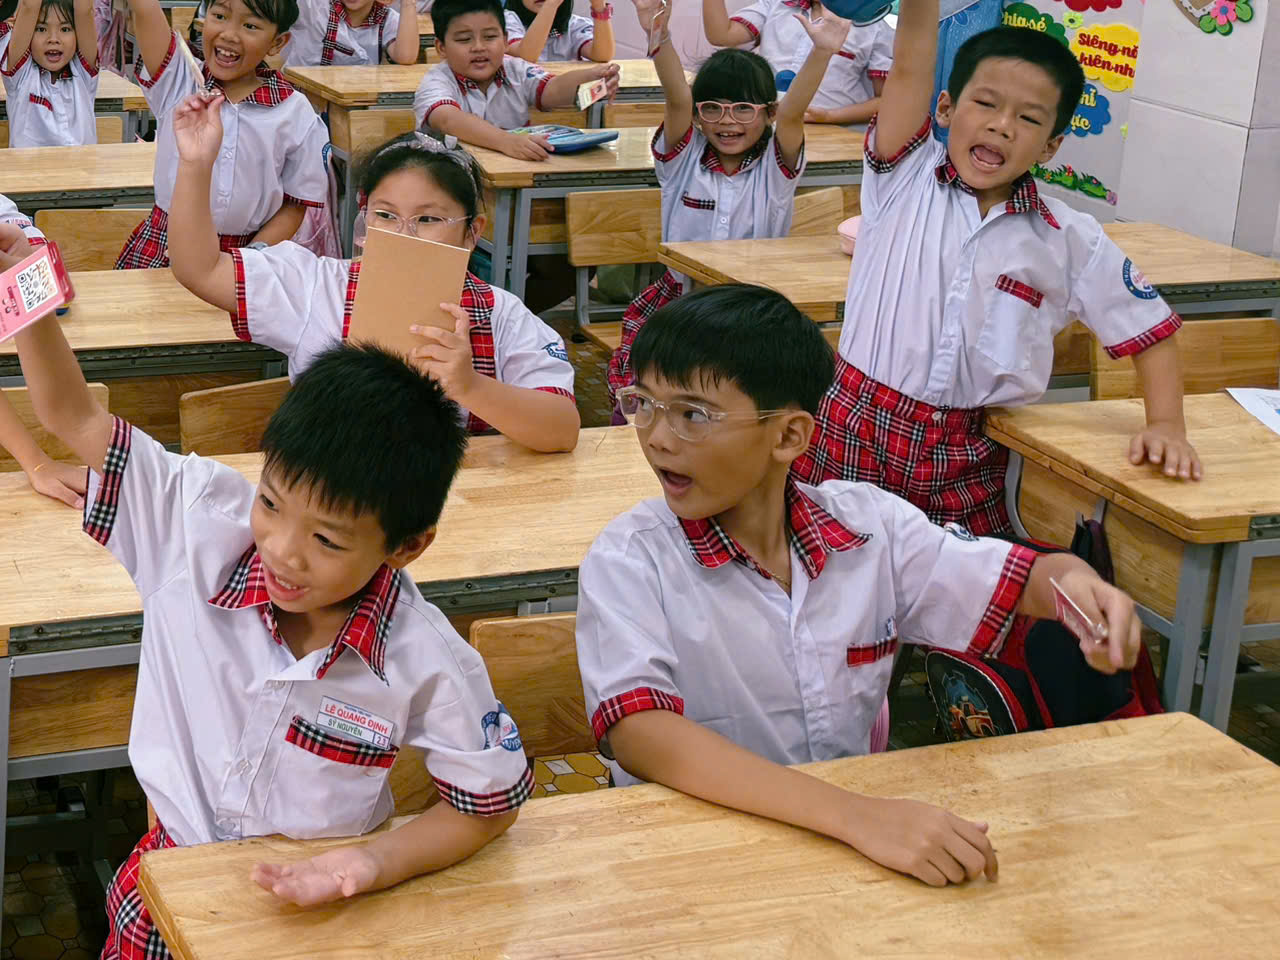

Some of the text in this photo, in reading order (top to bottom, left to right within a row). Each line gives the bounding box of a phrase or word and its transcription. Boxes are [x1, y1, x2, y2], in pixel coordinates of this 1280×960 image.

[1003, 10, 1026, 28] hia
[1113, 62, 1135, 79] nh
[324, 704, 337, 715] LÊ
[337, 708, 368, 726] QUANG
[368, 719, 388, 735] ĐỊNH
[337, 720, 363, 737] NGUYÊN
